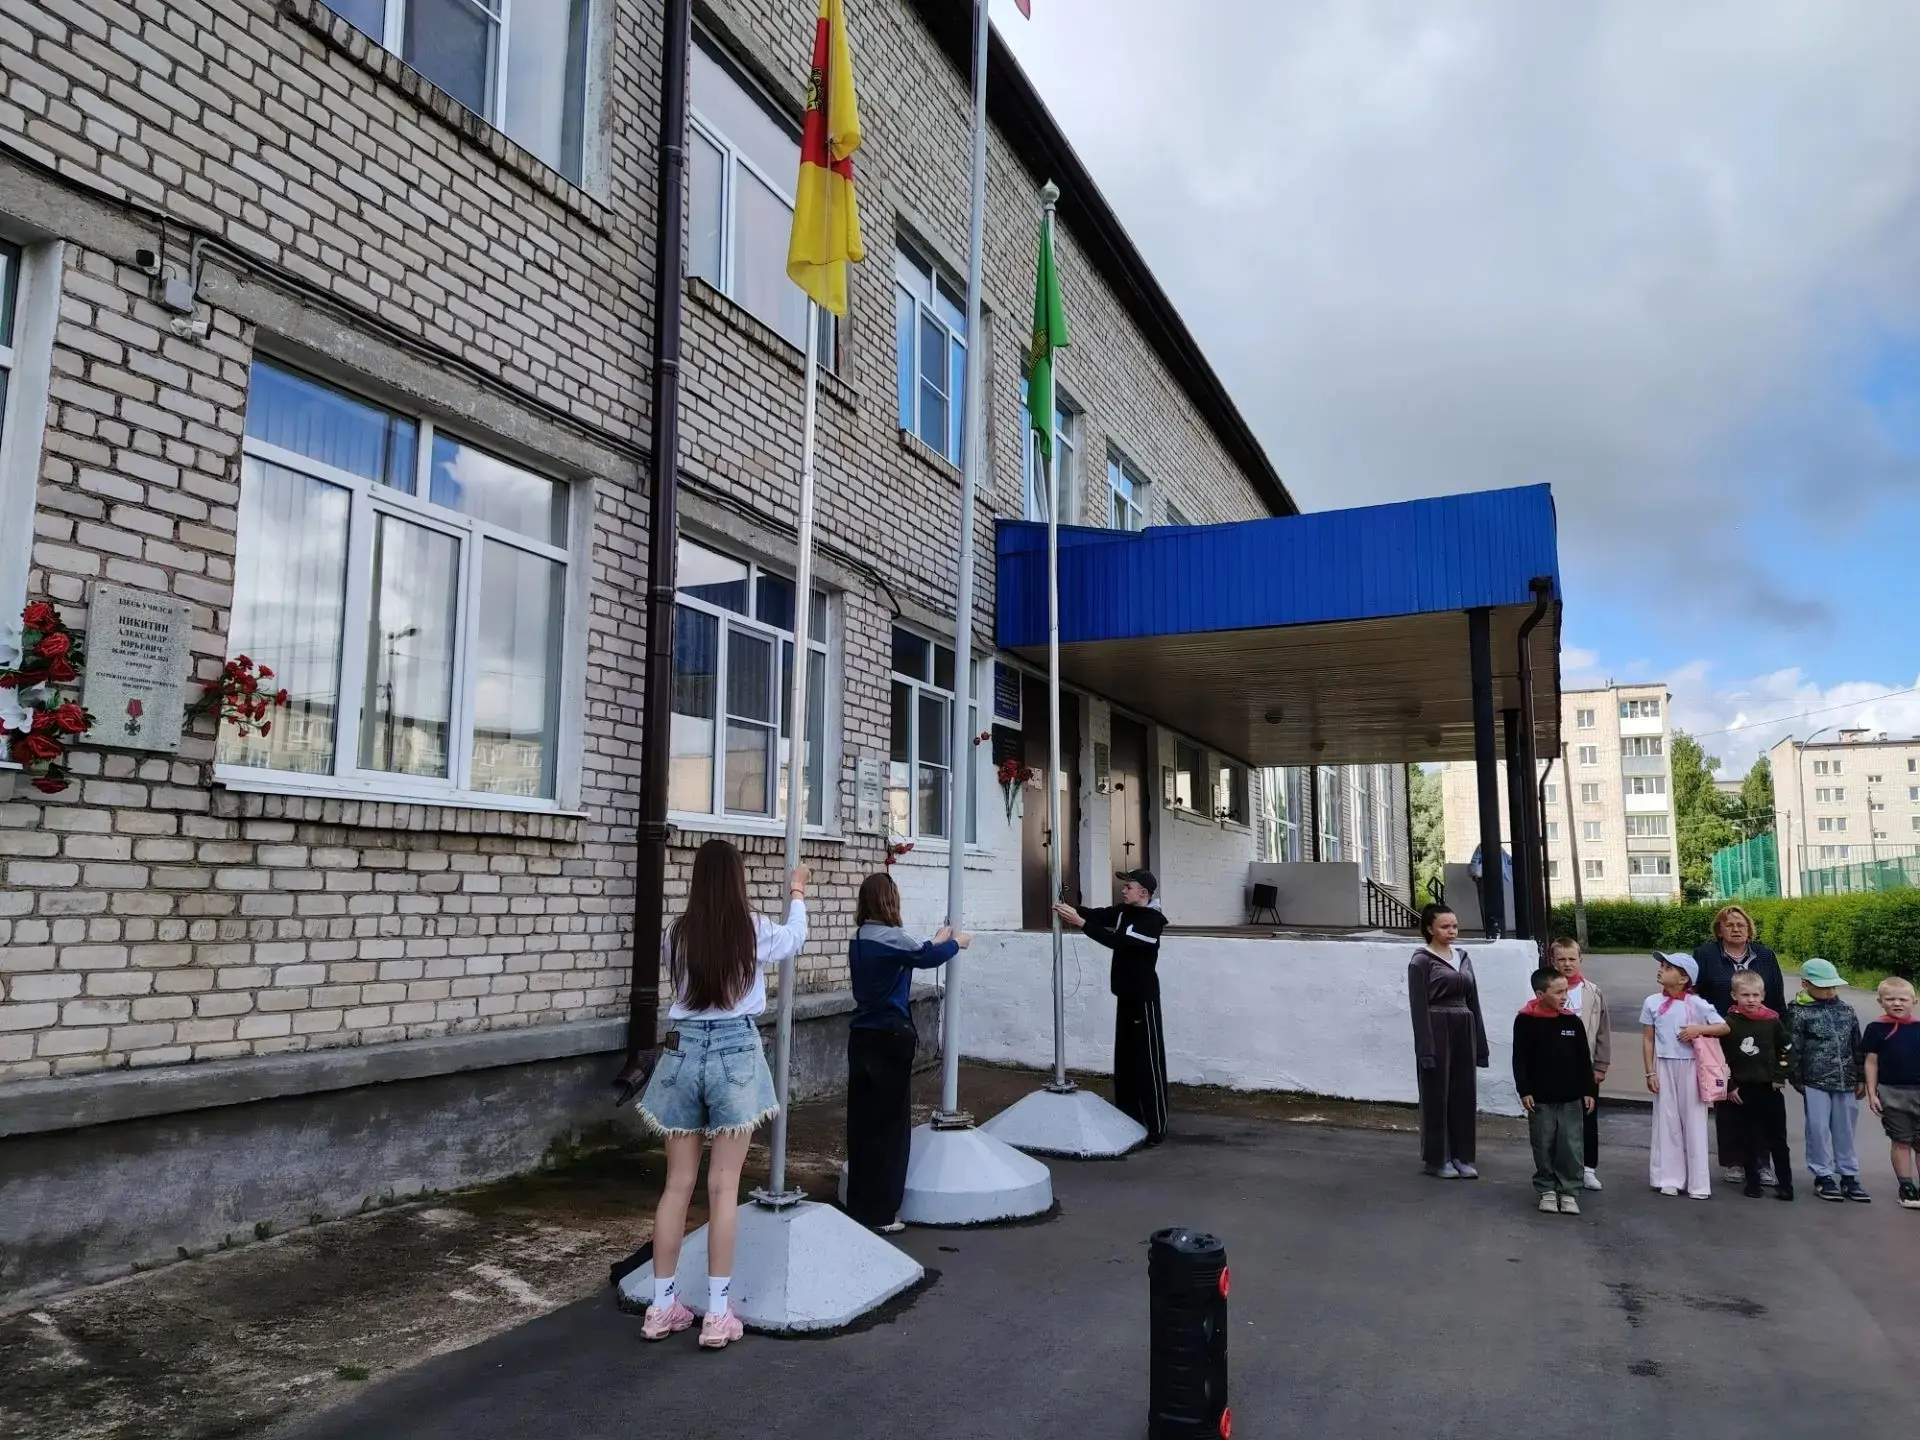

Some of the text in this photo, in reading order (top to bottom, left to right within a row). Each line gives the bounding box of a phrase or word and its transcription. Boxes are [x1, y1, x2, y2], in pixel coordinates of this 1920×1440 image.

[119, 615, 168, 633] НИКИТИН
[119, 628, 167, 643] АЛЕКСАНДР
[120, 639, 162, 653] ЮРЬЕВИЧ
